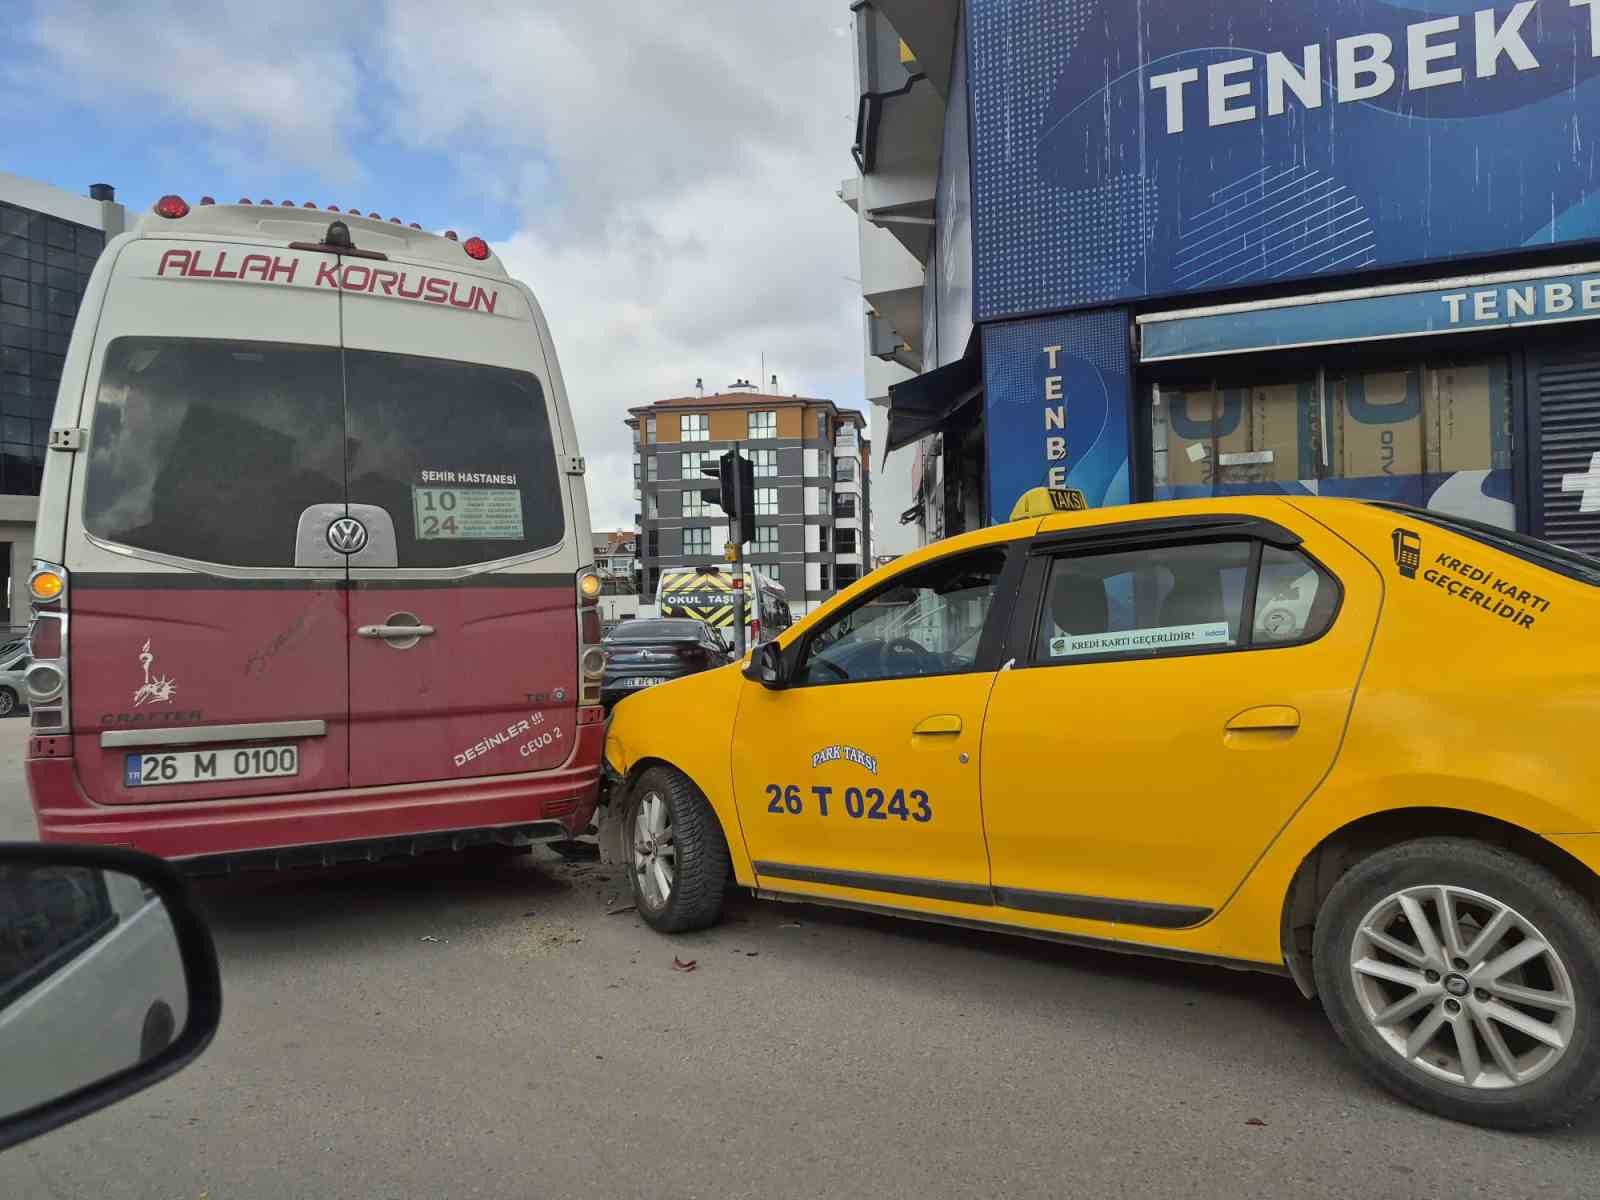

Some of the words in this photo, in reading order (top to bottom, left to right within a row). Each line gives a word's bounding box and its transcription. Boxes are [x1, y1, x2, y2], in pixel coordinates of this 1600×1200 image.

[1150, 1, 1540, 134] TENBEK
[158, 250, 298, 283] ALLAH
[316, 262, 498, 313] KORUSUN
[1441, 280, 1600, 323] TENBE
[424, 491, 456, 511] 10
[423, 515, 458, 536] 24
[667, 596, 702, 604] OKUL
[1424, 569, 1535, 630] GEÇERLİDİR
[1435, 553, 1494, 585] KREDİ
[1492, 579, 1551, 612] KARTI
[454, 720, 530, 767] DESİNLER
[553, 727, 563, 739] 2
[143, 756, 178, 782] 26
[194, 753, 217, 778] M
[234, 748, 296, 775] 0100
[812, 745, 841, 768] PARK
[766, 784, 803, 815] 26
[811, 786, 833, 816] T
[845, 788, 932, 822] 0243
